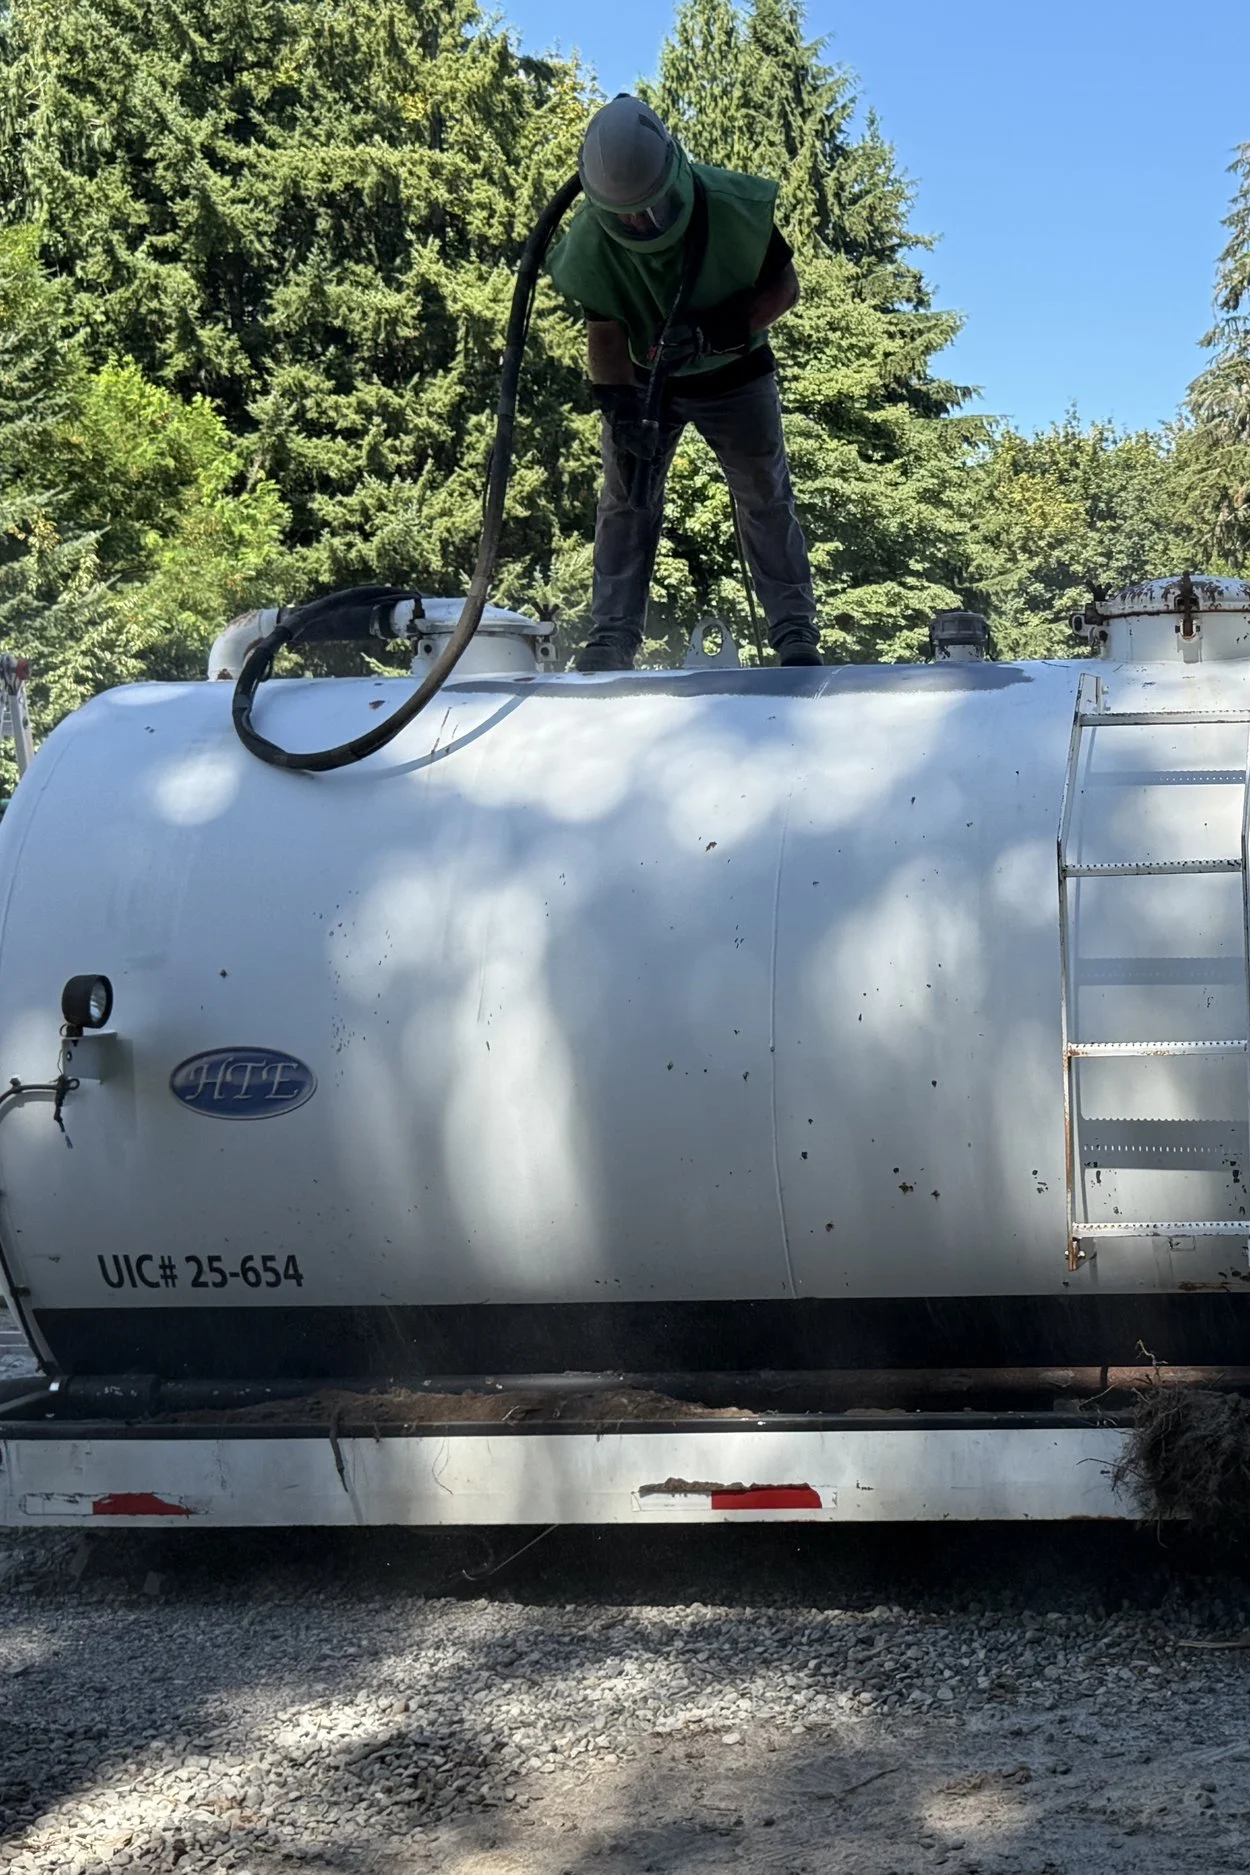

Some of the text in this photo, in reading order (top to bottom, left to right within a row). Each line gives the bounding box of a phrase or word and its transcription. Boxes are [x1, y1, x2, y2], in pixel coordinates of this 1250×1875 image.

[184, 1057, 300, 1100] HTE
[98, 1254, 304, 1288] UIC# 25-654
